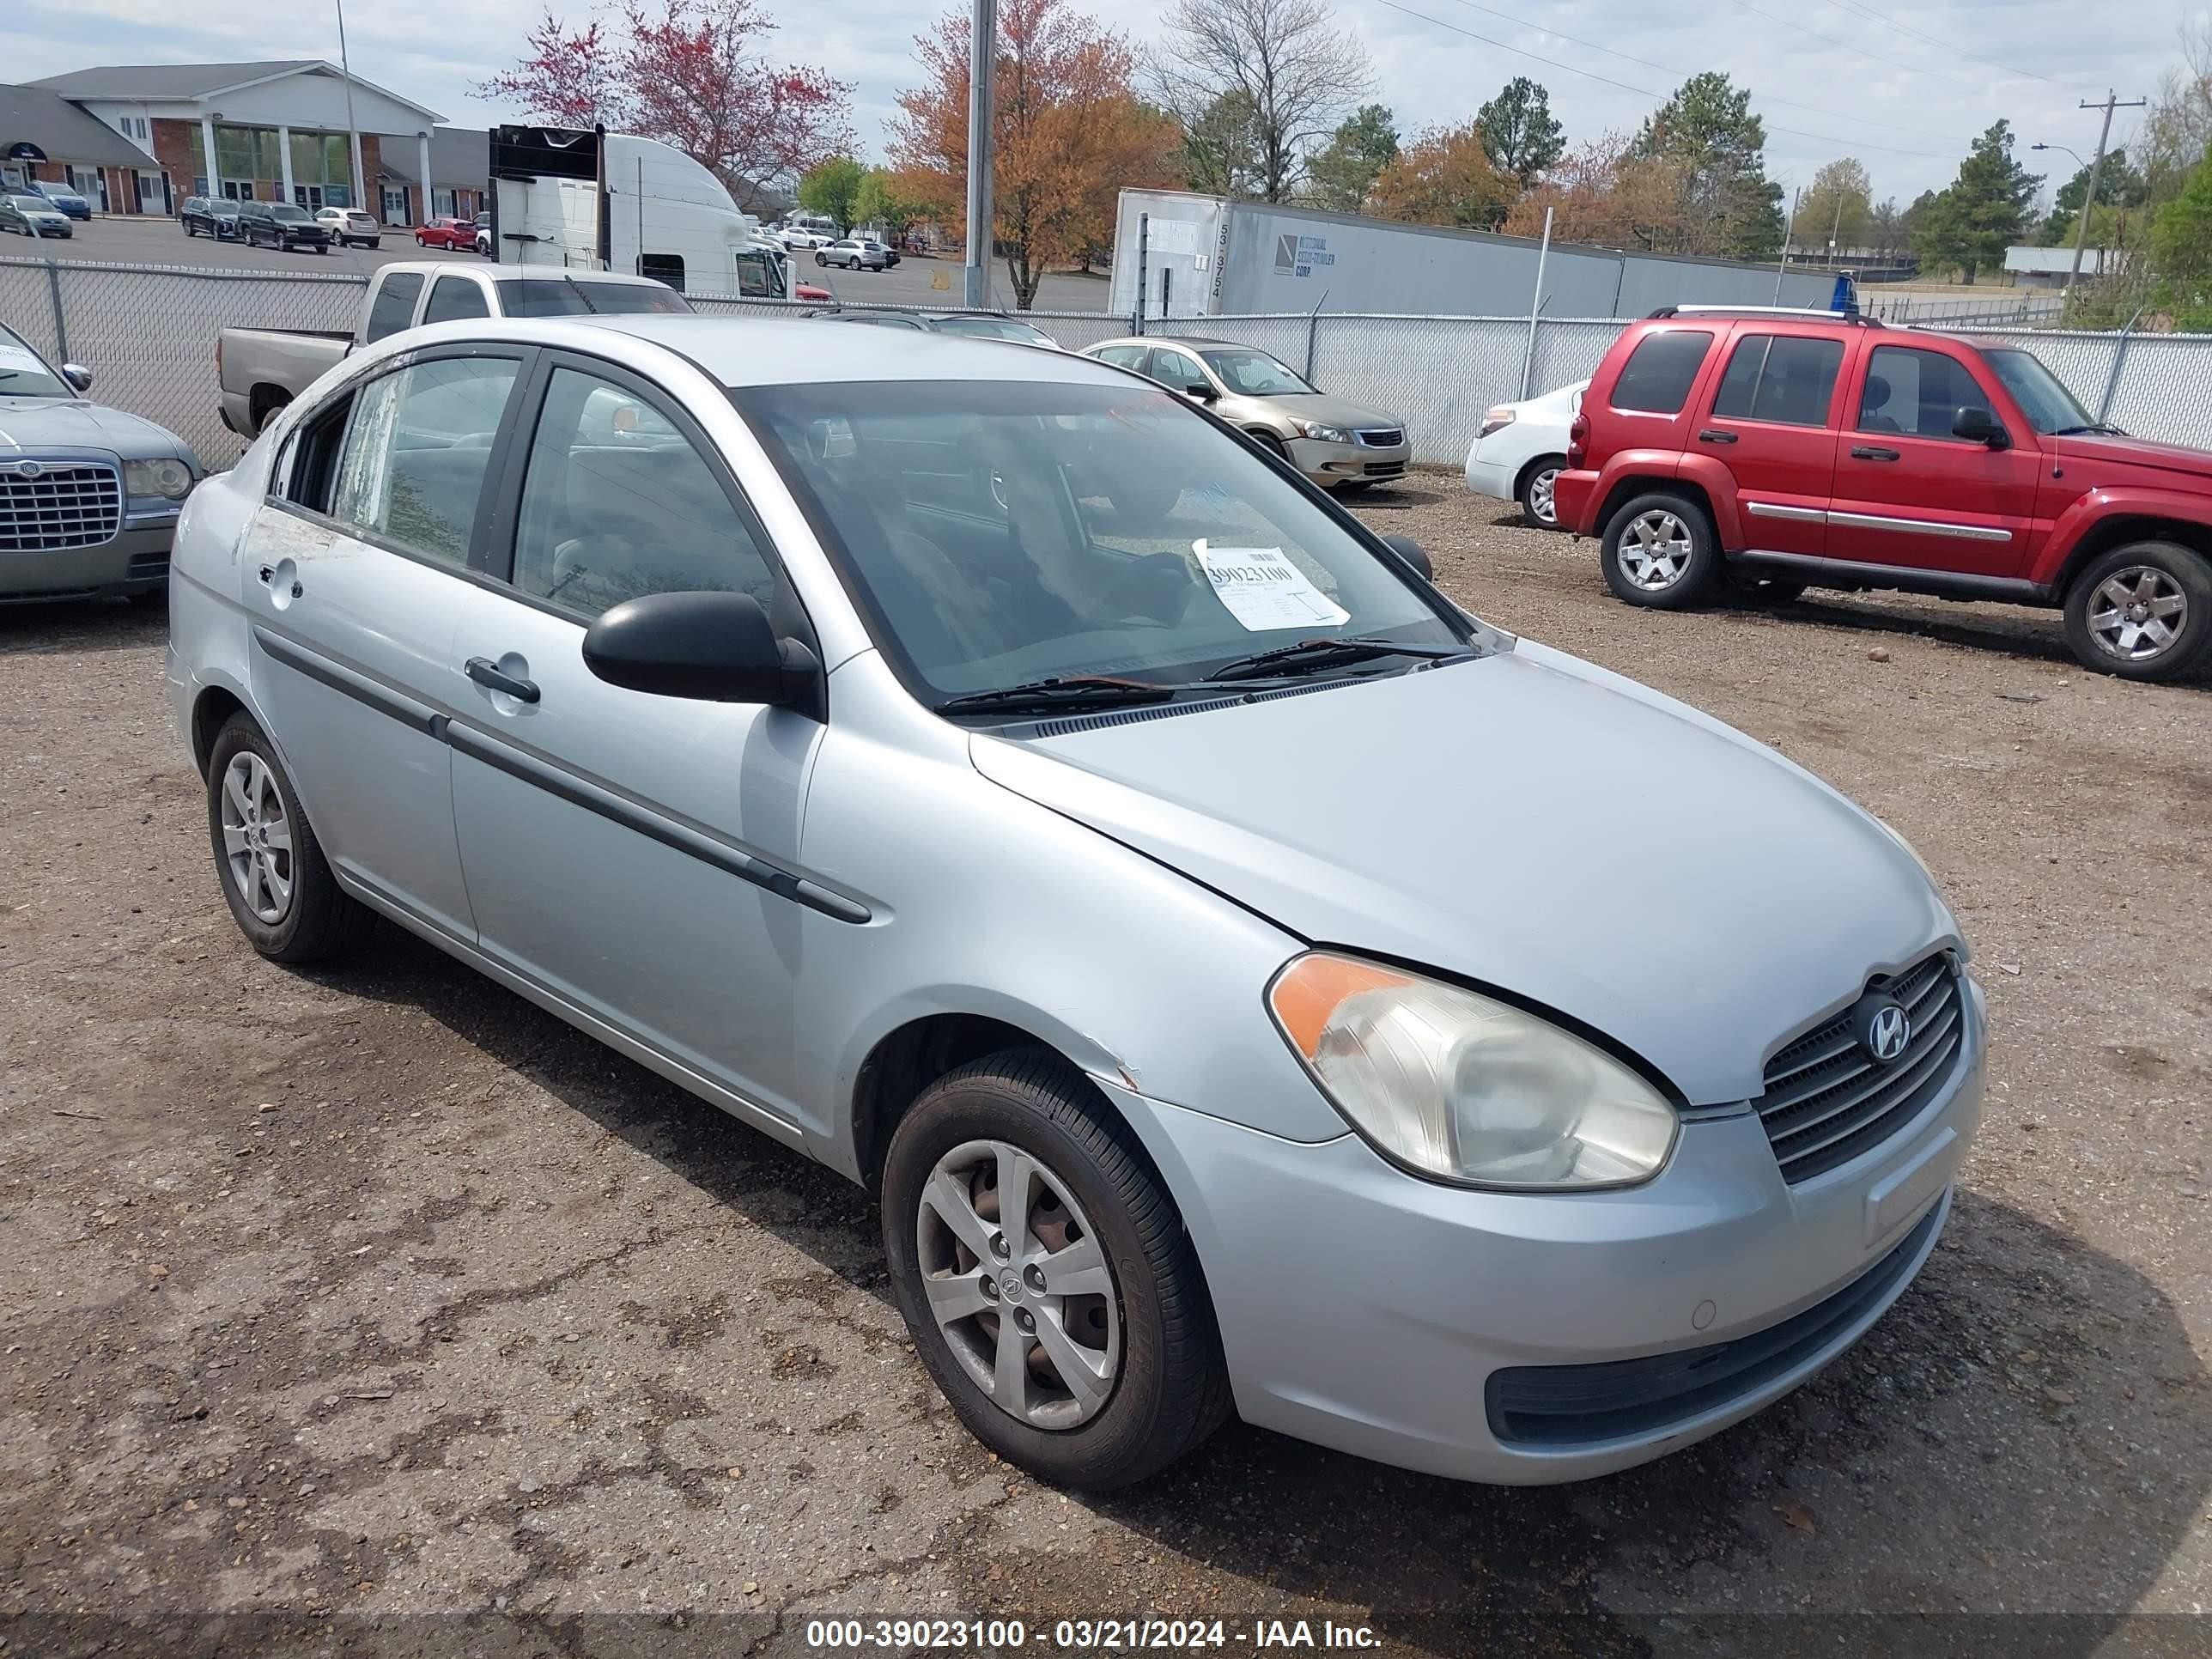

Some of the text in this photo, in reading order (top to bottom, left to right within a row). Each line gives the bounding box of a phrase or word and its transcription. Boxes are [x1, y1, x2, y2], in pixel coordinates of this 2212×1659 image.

[1212, 224, 1229, 298] 53-3754
[1295, 265, 1311, 278] CORP.
[1208, 567, 1292, 583] 39023100
